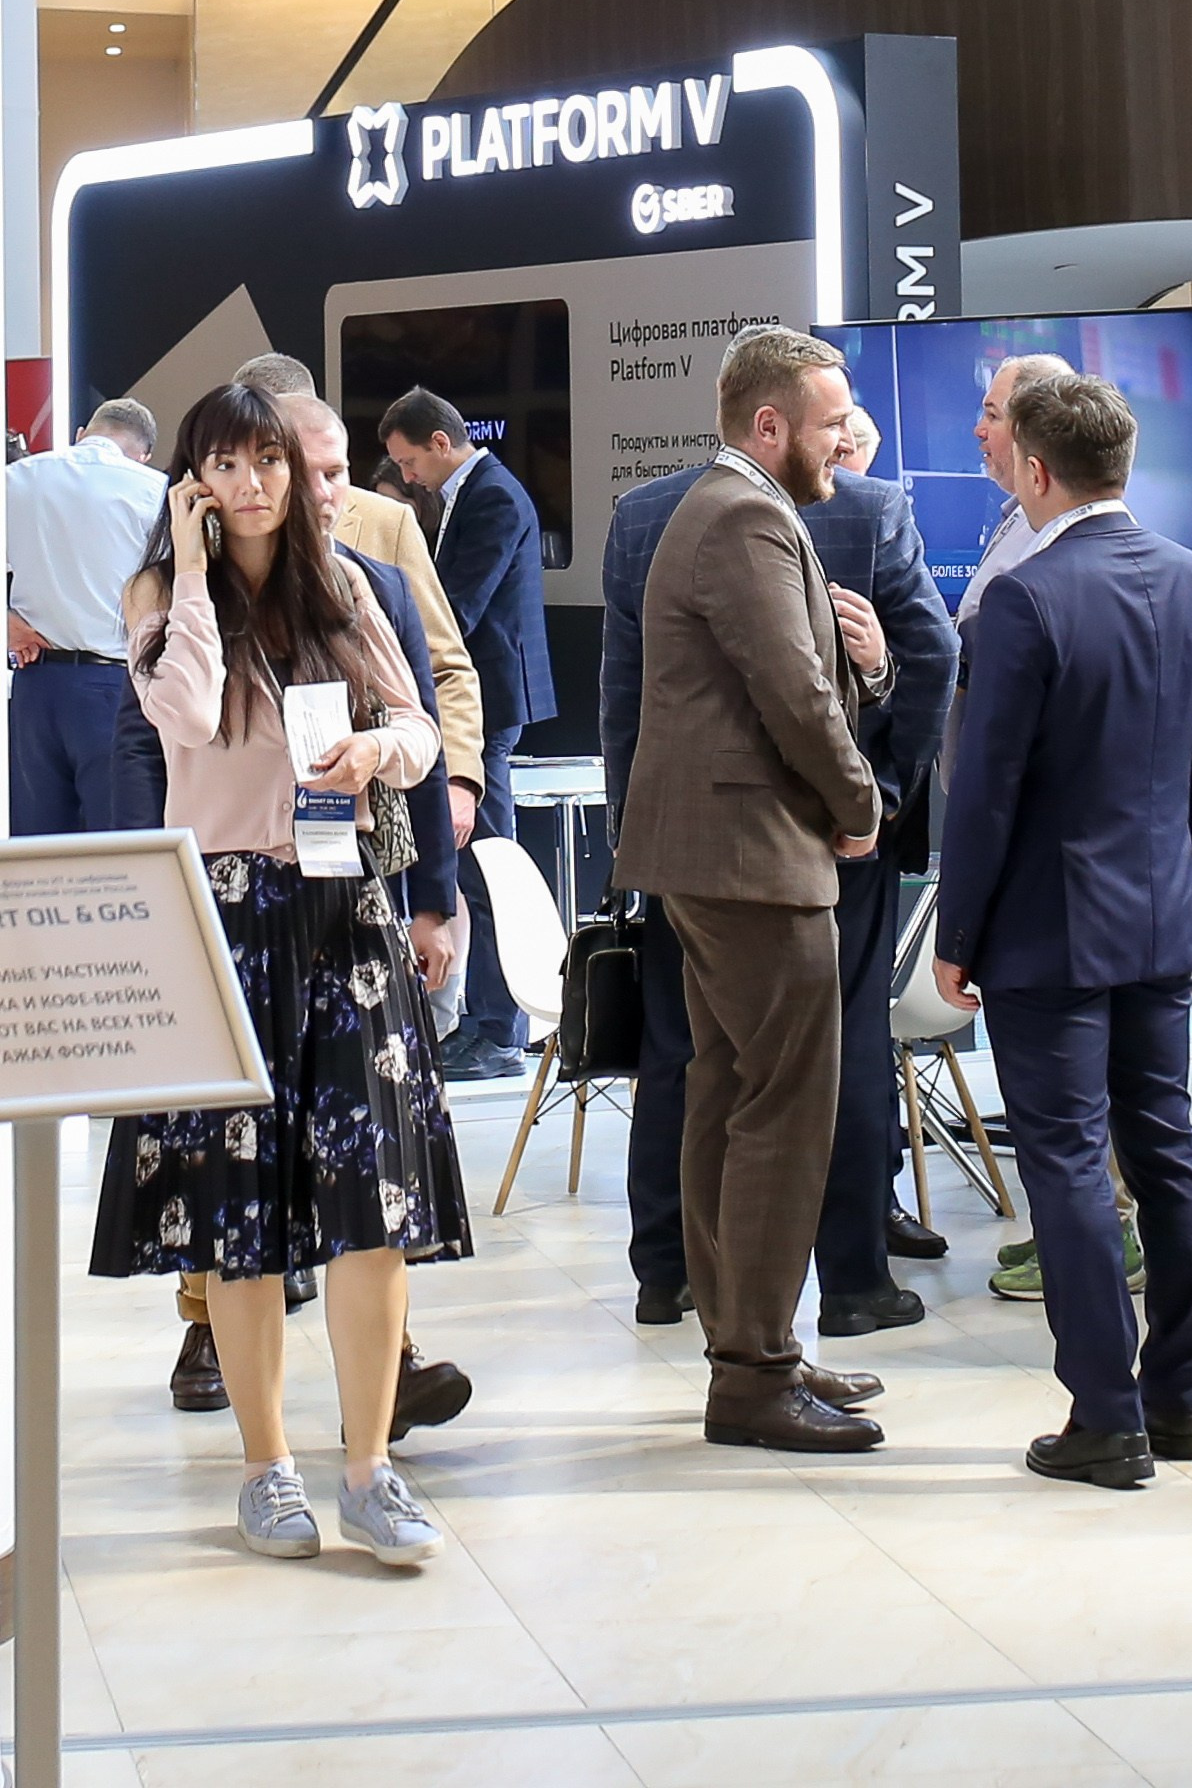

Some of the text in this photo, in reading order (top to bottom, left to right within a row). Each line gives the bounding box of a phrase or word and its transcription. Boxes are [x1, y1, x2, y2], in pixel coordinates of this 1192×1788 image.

[421, 74, 731, 181] PLATFORM V
[662, 184, 735, 223] SBER
[610, 319, 687, 347] Цифровая
[610, 355, 692, 381] Platform V
[495, 420, 505, 440] V
[612, 433, 668, 453] Продукты
[672, 435, 678, 447] и
[612, 466, 632, 481] для
[635, 459, 684, 478] быстрой
[931, 565, 963, 578] БОЛЕЕ
[27, 906, 70, 926] OIL
[76, 904, 93, 922] &
[98, 900, 150, 921] GAS
[40, 961, 149, 980] УЧАСТНИКИ,
[23, 995, 36, 1010] И
[41, 986, 161, 1008] КОФЕ-БРЕЙКИ
[25, 1019, 59, 1036] ВАС
[62, 1018, 86, 1032] НА
[91, 1014, 134, 1030] ВСЕХ
[57, 1040, 136, 1059] ФОРУМА
